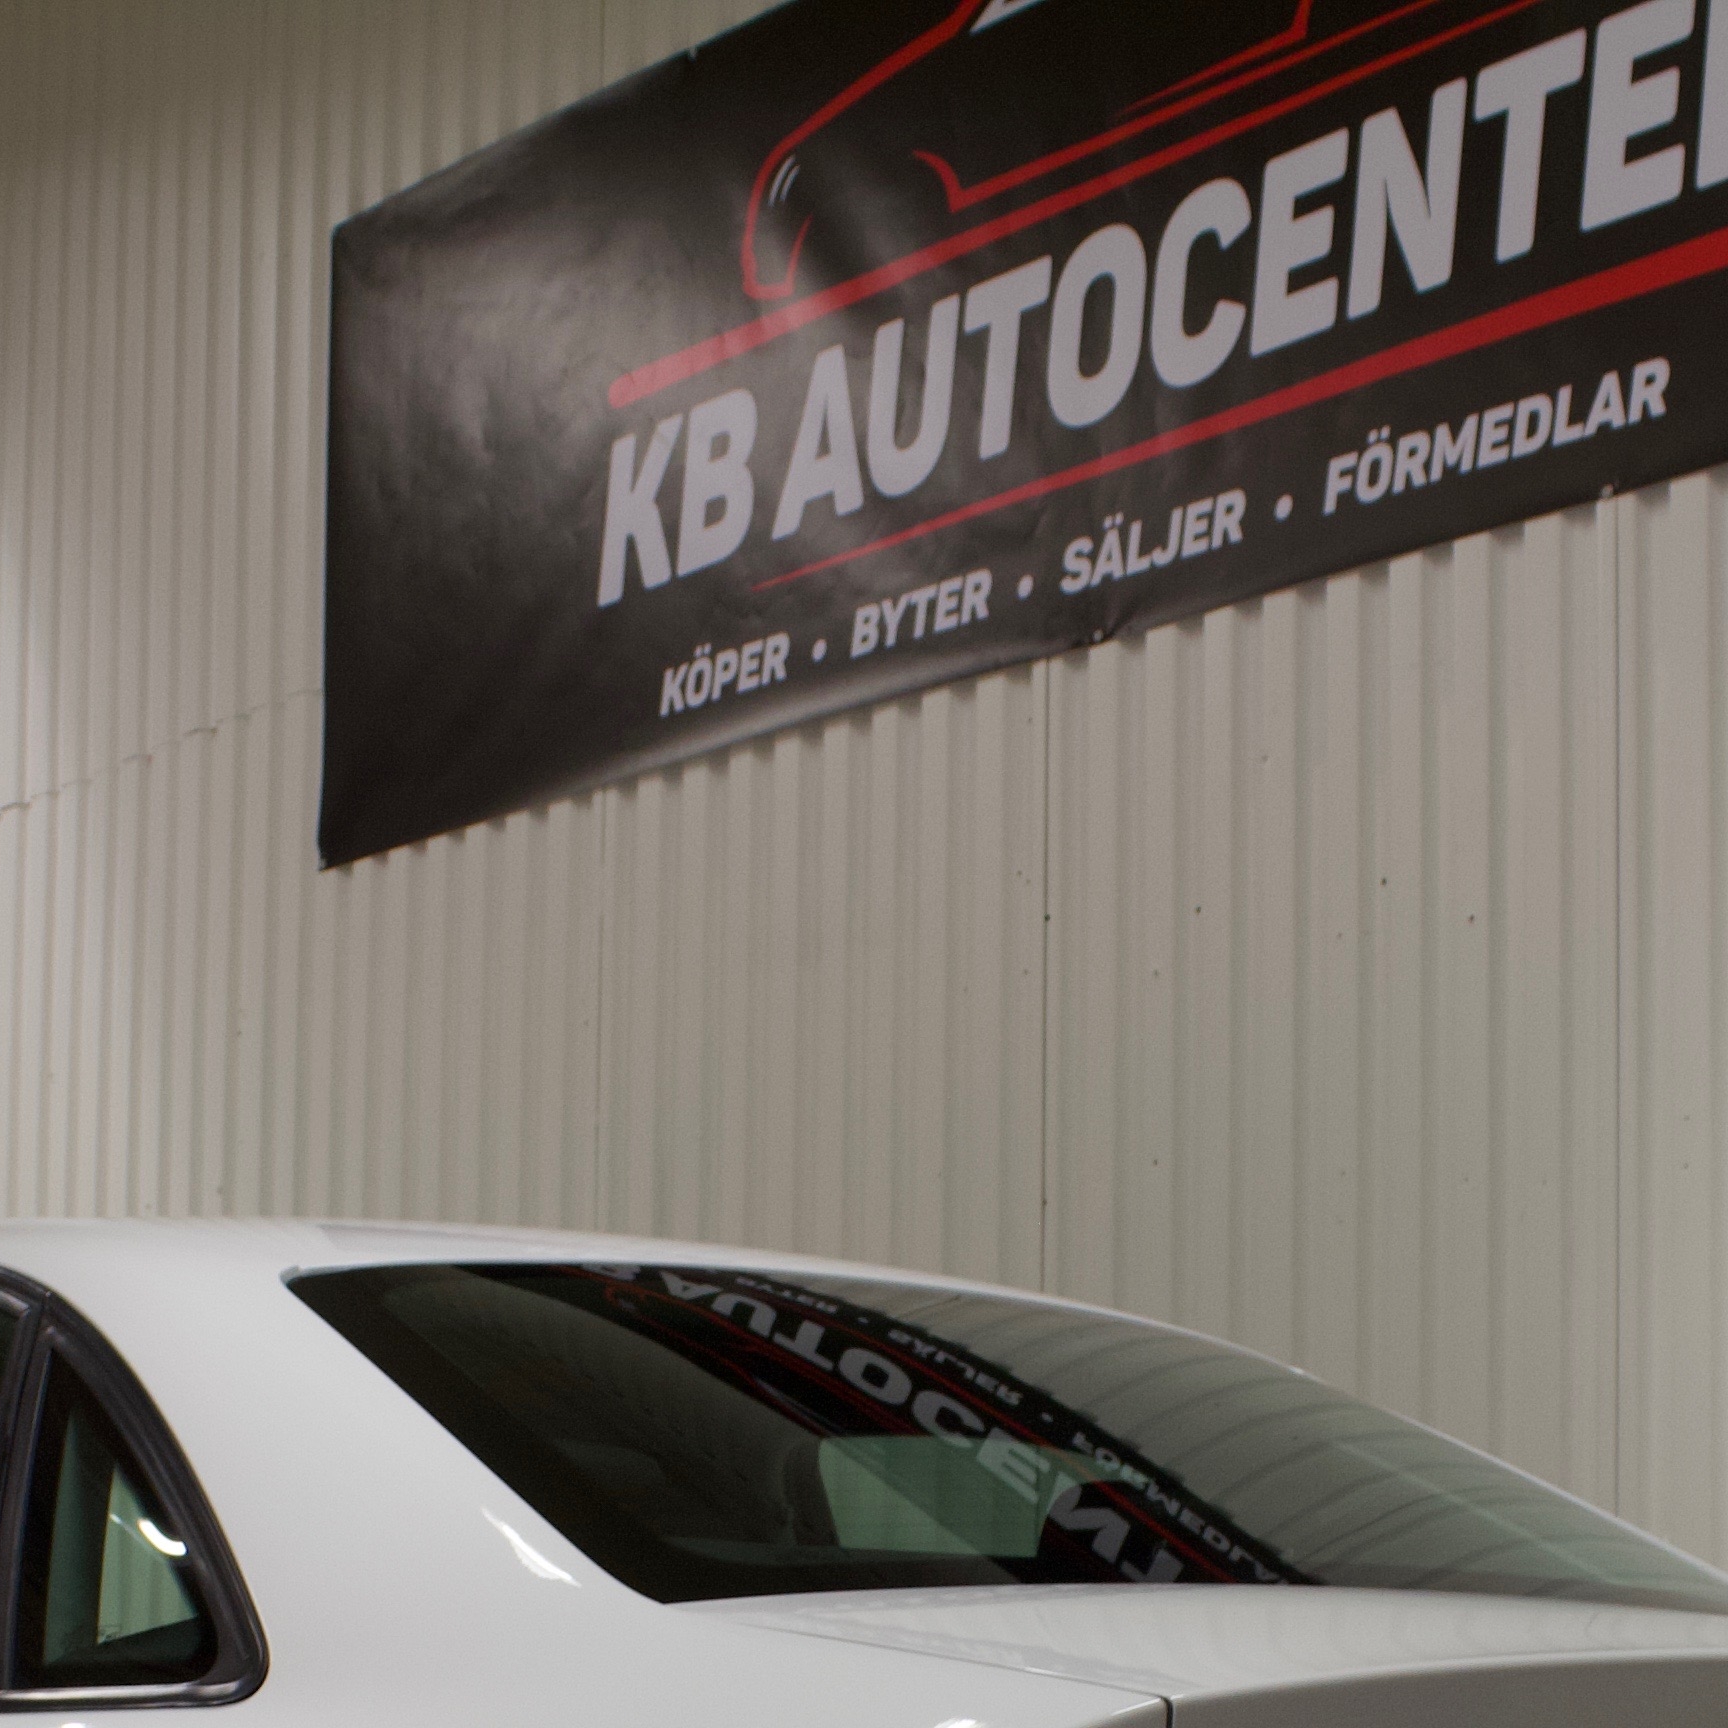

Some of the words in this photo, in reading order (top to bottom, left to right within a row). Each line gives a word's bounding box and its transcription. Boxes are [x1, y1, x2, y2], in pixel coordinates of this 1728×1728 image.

[597, 387, 758, 609] KB
[658, 631, 790, 718] KÖPER
[849, 568, 992, 660] BYTER
[1059, 487, 1247, 595] SÄLJER
[1322, 356, 1672, 516] FÖRMEDLAR
